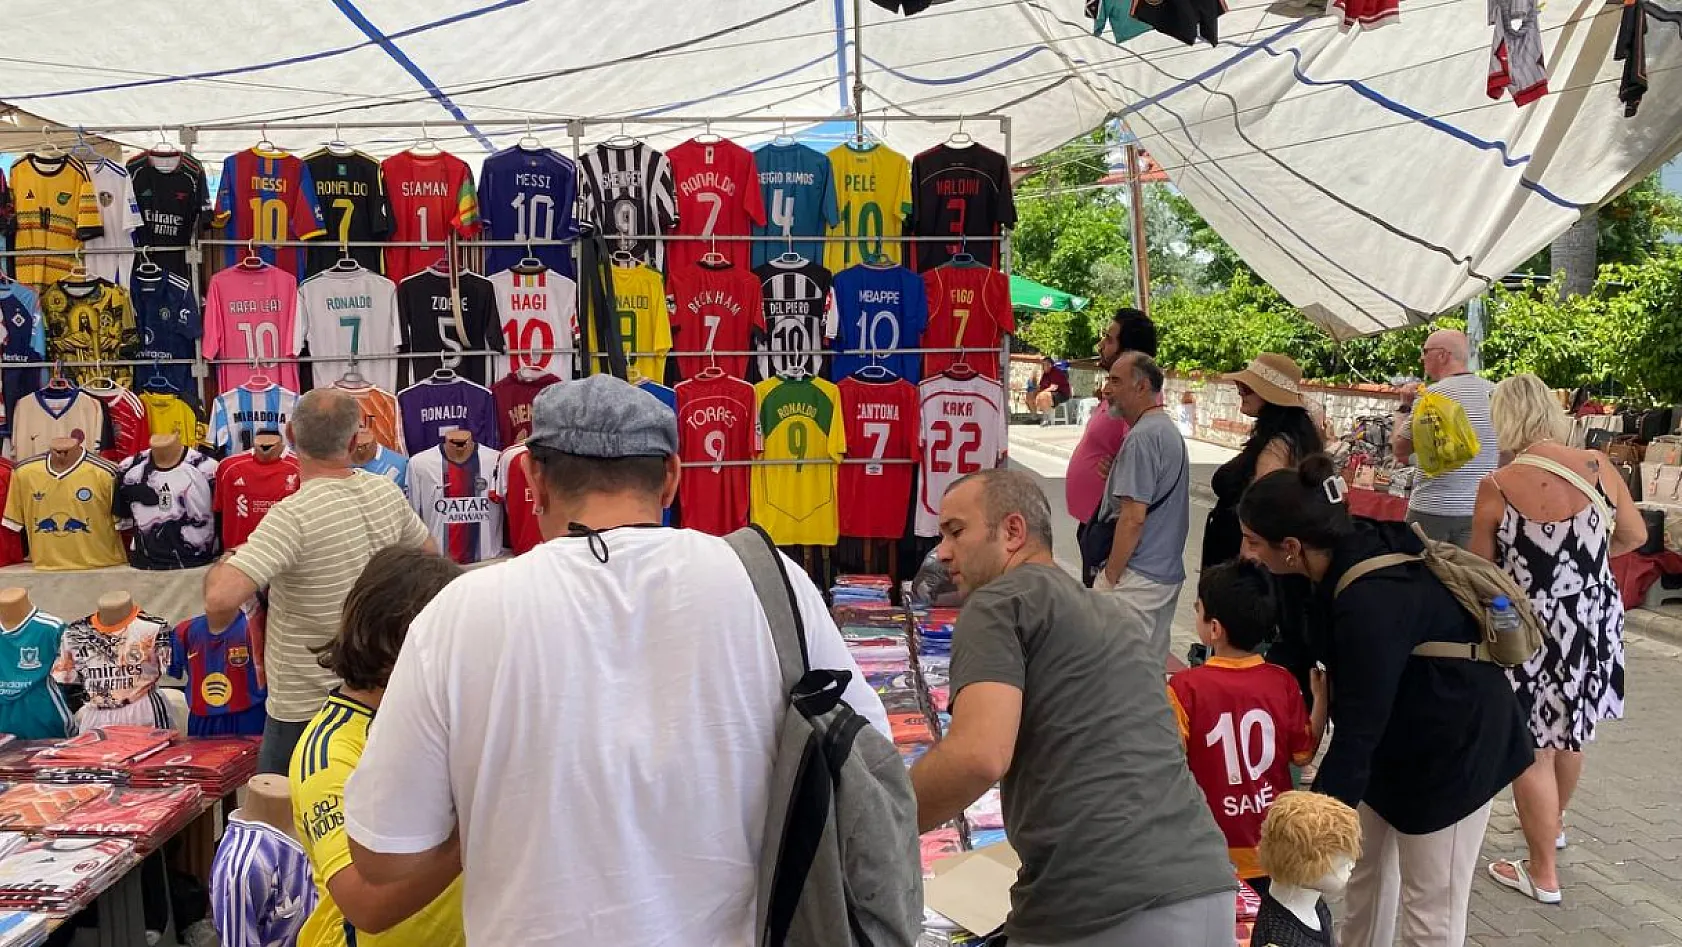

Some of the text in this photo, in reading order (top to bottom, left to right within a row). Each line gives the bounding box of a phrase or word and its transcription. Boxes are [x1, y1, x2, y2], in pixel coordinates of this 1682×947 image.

[251, 176, 288, 193] MESSI
[316, 180, 368, 197] RONALDO
[515, 173, 552, 189] MESSI
[680, 171, 736, 197] RONALDO
[249, 197, 289, 249] 10
[332, 198, 355, 252] 7
[416, 206, 429, 251] 1
[511, 192, 555, 242] 10
[696, 192, 722, 243] 7
[772, 188, 795, 237] 4
[841, 200, 884, 264] 10
[327, 296, 373, 310] RONALDO
[510, 293, 547, 311] HAGI
[687, 290, 743, 317] BECKHAM
[770, 301, 784, 316] DEL
[858, 289, 900, 305] MBAPPE
[949, 289, 975, 304] FIGO
[237, 321, 280, 369] 10
[339, 315, 362, 362] 7
[437, 316, 463, 369] 5
[502, 317, 555, 374] 10
[703, 315, 721, 354] 7
[774, 325, 805, 371] 10
[857, 310, 900, 360] 10
[952, 308, 971, 349] 7
[686, 404, 738, 431] TORRES
[776, 401, 818, 420] RONALDO
[704, 430, 726, 474] 9
[786, 420, 808, 474] 9
[862, 422, 891, 476] 7
[930, 420, 982, 474] 22
[434, 499, 490, 516] QATAR
[447, 513, 490, 522] AIRWAYS
[1205, 707, 1276, 786] 10
[1223, 781, 1274, 817] SANÉ
